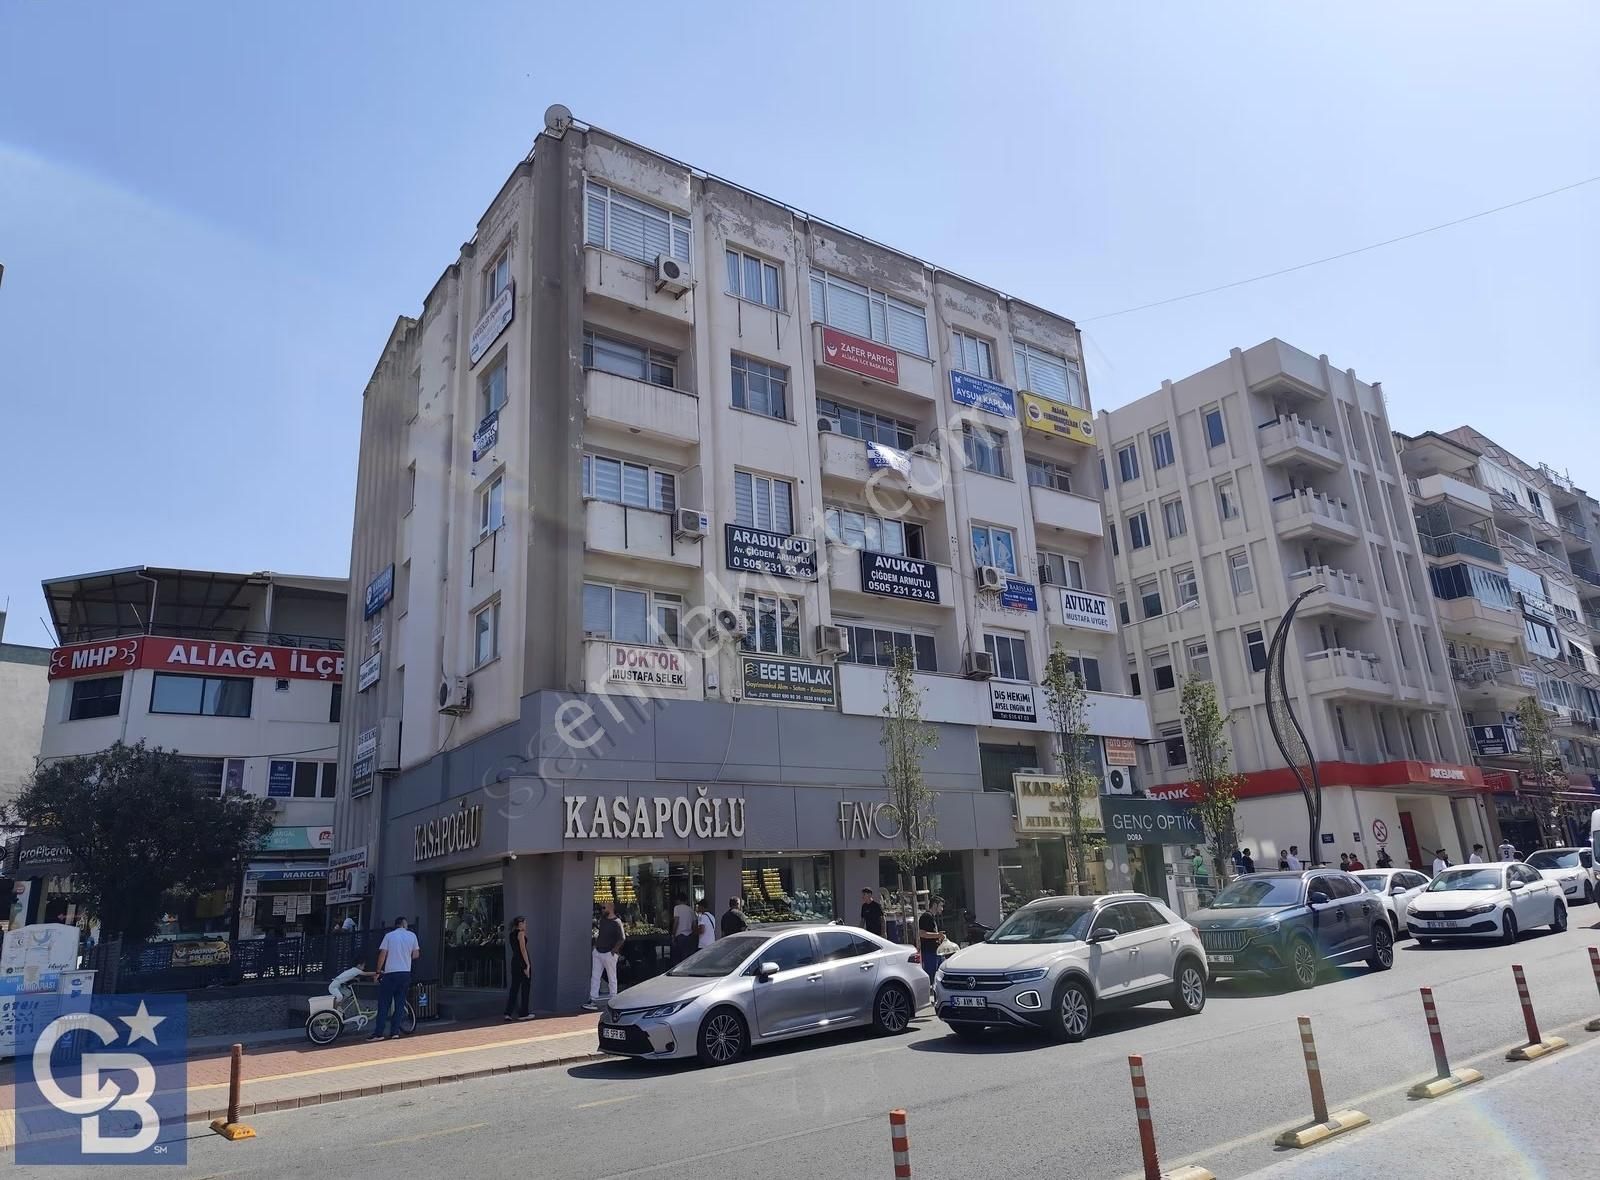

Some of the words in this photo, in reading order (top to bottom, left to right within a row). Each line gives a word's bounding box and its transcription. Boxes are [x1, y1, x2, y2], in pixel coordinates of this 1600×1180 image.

[840, 342, 866, 357] ZAFER
[866, 351, 895, 367] PARTİSİ
[956, 387, 981, 402] AYSUN
[983, 394, 1013, 411] KAPLAN
[733, 529, 810, 554] ARABULUCU
[733, 556, 740, 566] 0
[743, 558, 762, 570] 505
[764, 561, 781, 573] 231
[785, 565, 797, 576] 23
[800, 568, 812, 578] 43
[776, 553, 810, 564] ARMUTLU
[875, 556, 925, 575] AVUKAT
[868, 580, 891, 593] 0505
[893, 585, 909, 595] 231
[911, 588, 923, 598] 23
[924, 591, 936, 600] 43
[871, 569, 898, 583] ÇİĞDEM
[899, 575, 931, 589] ARMUTLU
[1065, 594, 1106, 616] AVUKAT
[1066, 613, 1090, 623] MUSTAFA
[71, 645, 118, 670] MHP
[166, 643, 276, 671] ALİAĞA
[616, 648, 680, 671] DOKTOR
[612, 669, 654, 682] MUSTAFA
[655, 672, 684, 685] SELEK
[760, 663, 785, 681] EGE
[789, 666, 832, 686] EMLAK
[995, 702, 1009, 711] AYSEL
[563, 786, 746, 840] KASAPOĞLU
[1112, 813, 1153, 832] GENÇ
[1157, 813, 1196, 830] OPTİK
[412, 799, 480, 862] KASAPOĞLU
[1127, 833, 1143, 841] DORA
[282, 871, 326, 879] MANGAL
